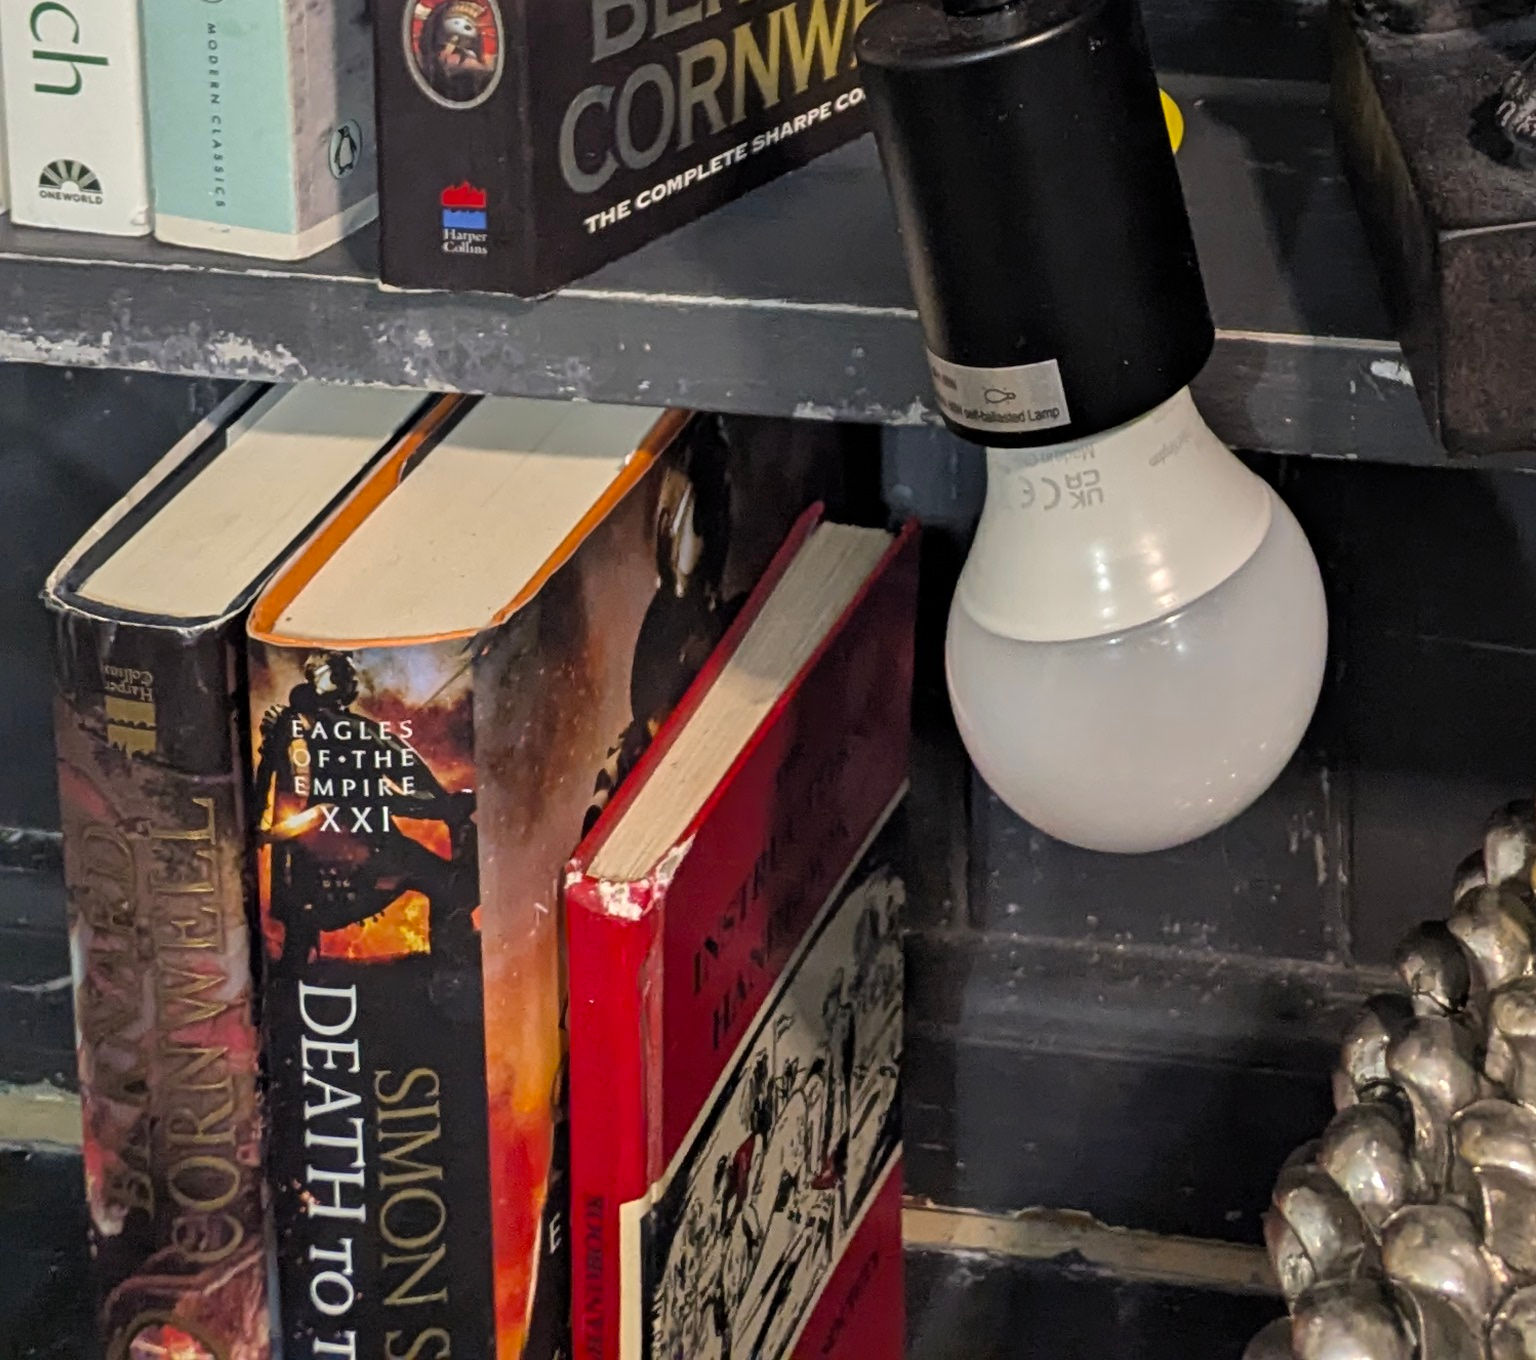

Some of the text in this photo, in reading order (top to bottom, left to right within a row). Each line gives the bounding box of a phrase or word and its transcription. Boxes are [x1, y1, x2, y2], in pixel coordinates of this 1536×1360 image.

[208, 21, 226, 208] MODERN CLASSICS
[583, 87, 867, 234] THE COMPLETE SHARPE CO
[39, 190, 103, 205] ONEWORLD
[442, 240, 488, 255] Collins
[443, 228, 488, 243] Harper
[1029, 406, 1061, 422] Lamp
[104, 682, 152, 703] Harper
[292, 720, 413, 740] EAGLES
[294, 776, 415, 797] EMPIRE
[320, 806, 390, 833] XXI
[150, 796, 244, 1263] CORNWELL
[299, 980, 366, 1225] DEATH
[374, 1067, 449, 1306] SIMON
[309, 1237, 354, 1317] TO
